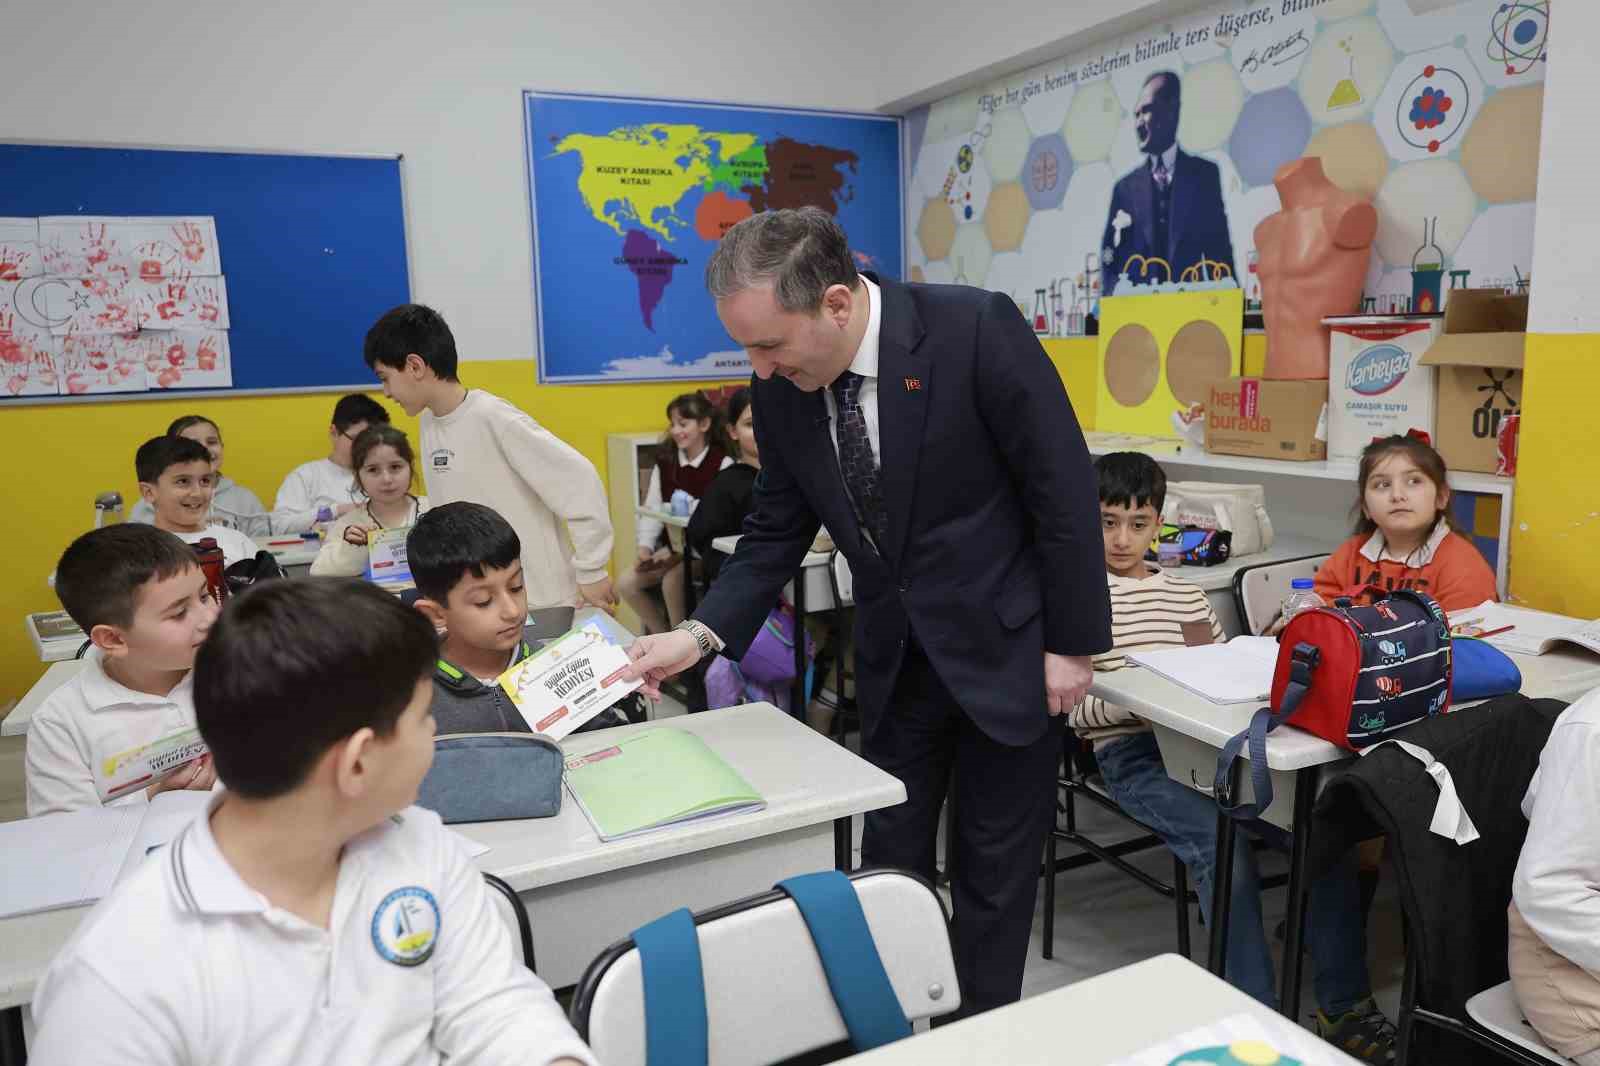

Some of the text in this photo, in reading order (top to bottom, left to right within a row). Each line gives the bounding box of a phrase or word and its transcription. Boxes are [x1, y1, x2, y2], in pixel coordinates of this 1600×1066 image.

[1044, 71, 1078, 92] benim
[1081, 52, 1130, 80] sözlerim
[1135, 32, 1181, 63] bilimle
[1185, 26, 1210, 47] ters
[1214, 6, 1274, 37] düşerse,
[1345, 352, 1412, 389] Karbeyaz
[1209, 383, 1240, 412] hep
[1209, 410, 1272, 433] burada
